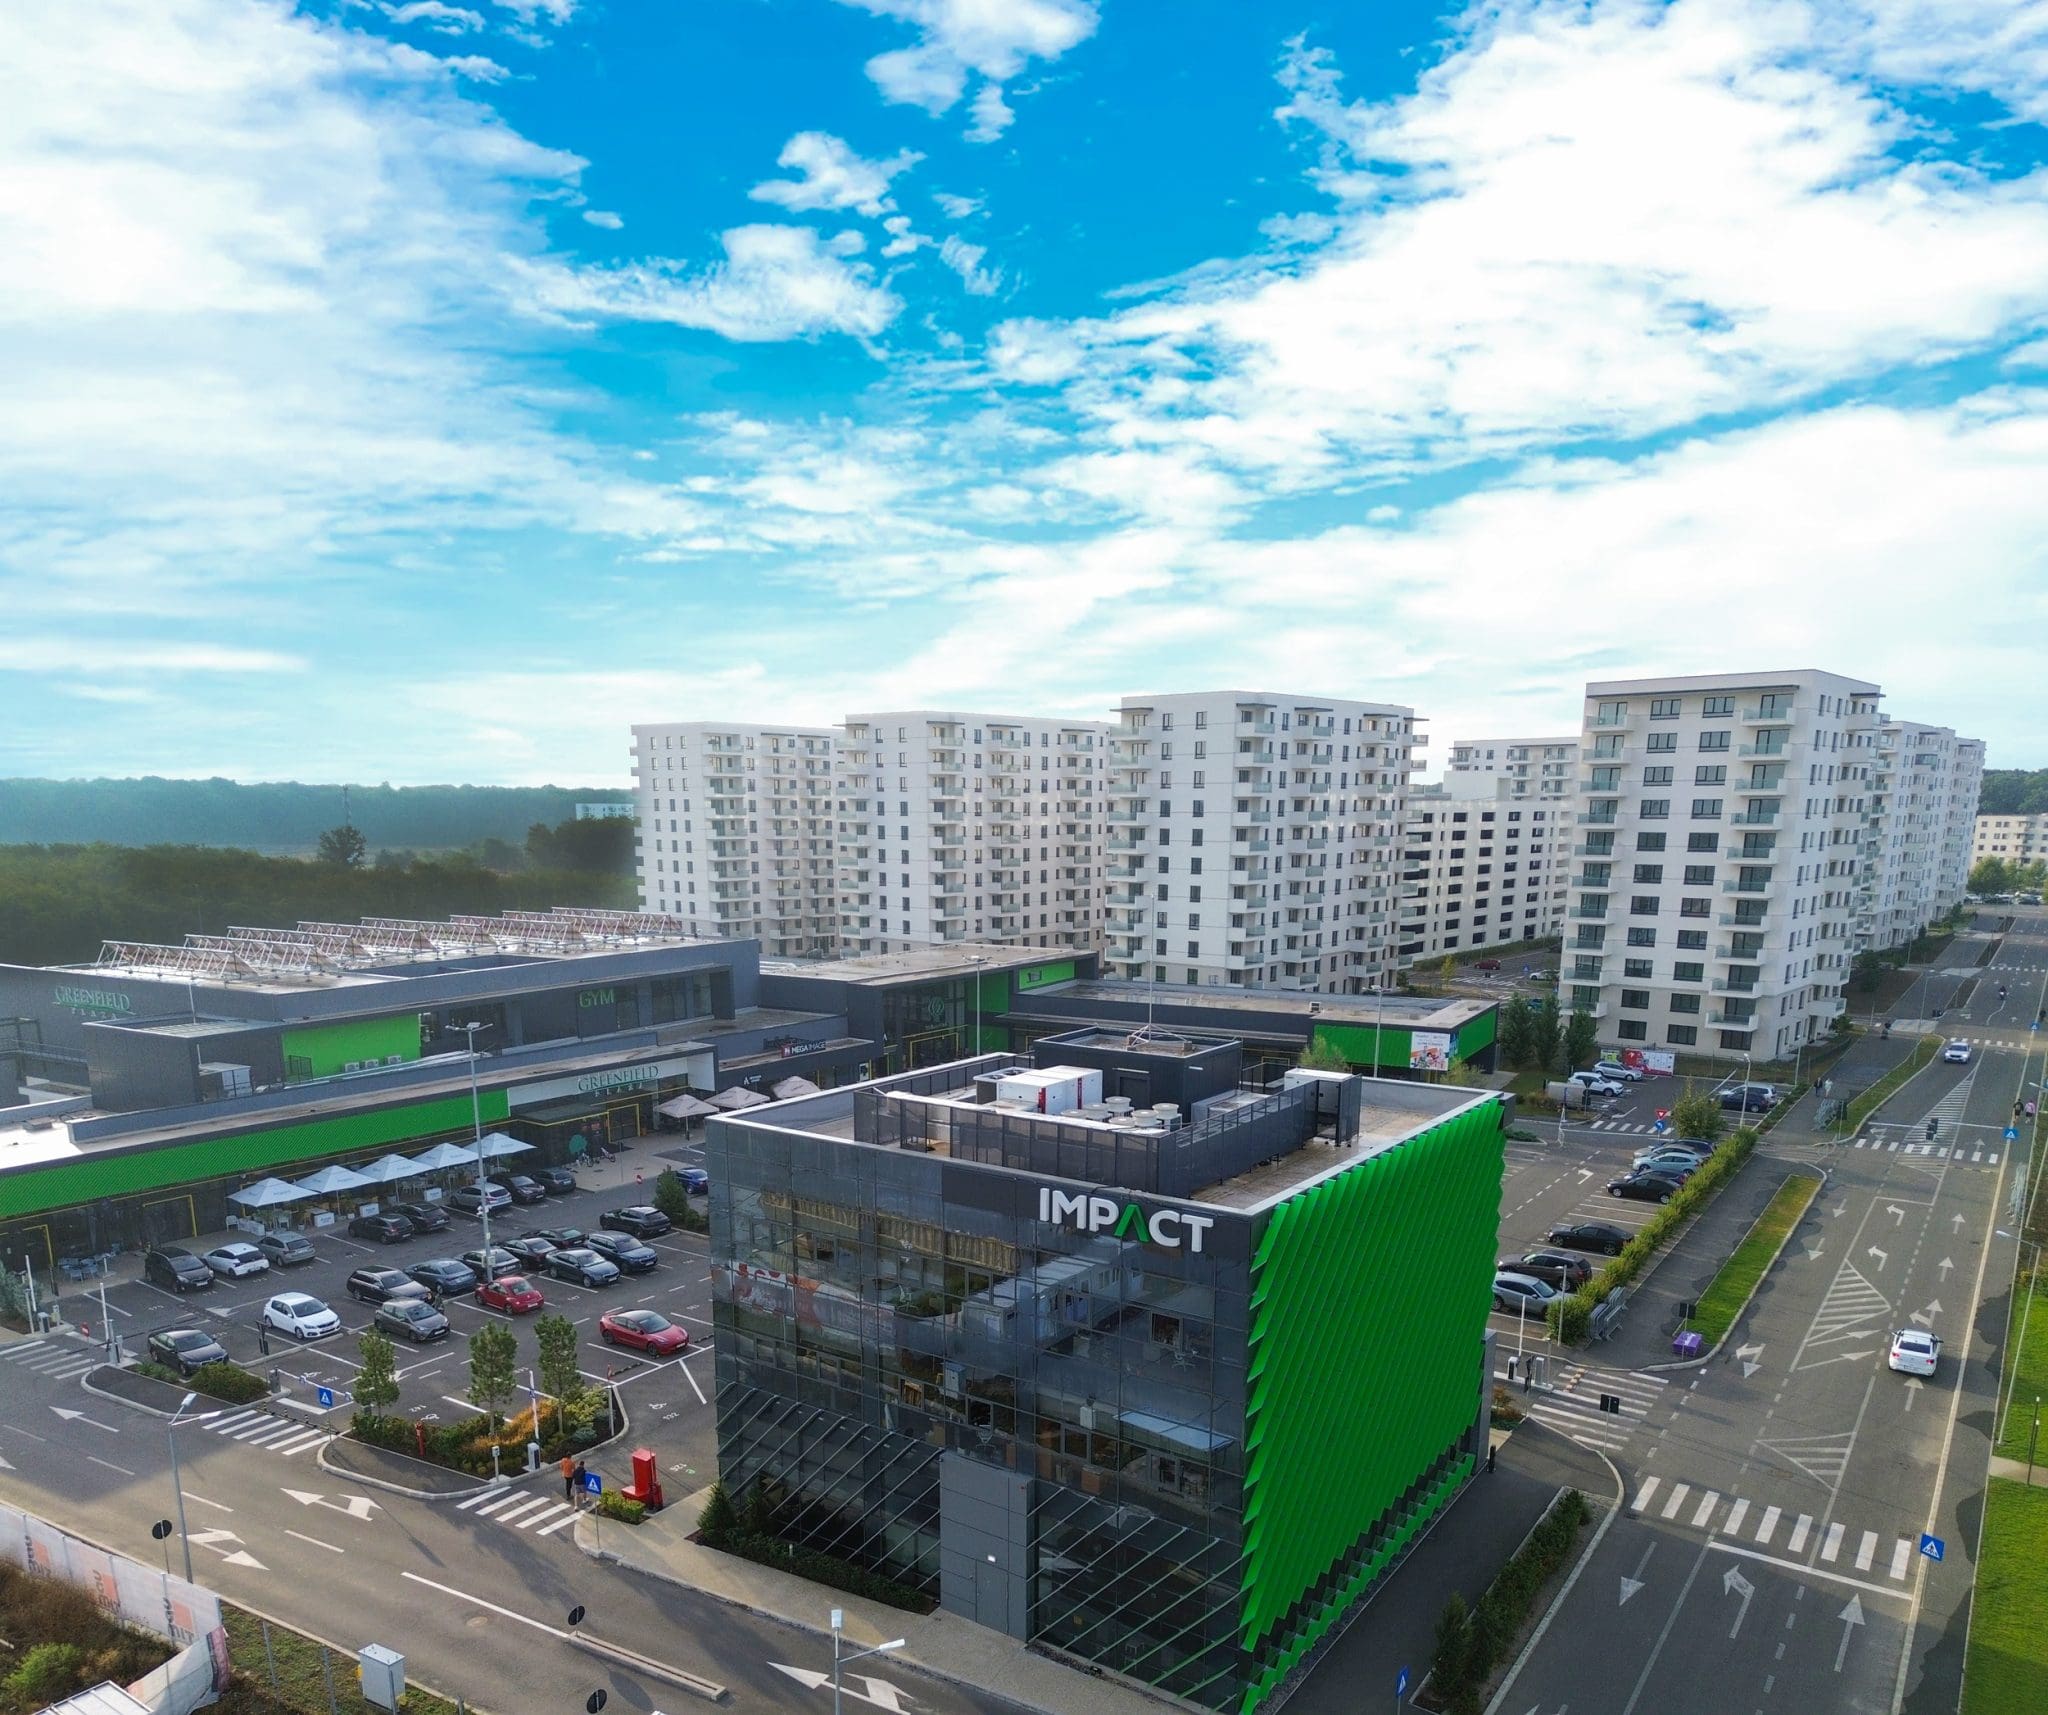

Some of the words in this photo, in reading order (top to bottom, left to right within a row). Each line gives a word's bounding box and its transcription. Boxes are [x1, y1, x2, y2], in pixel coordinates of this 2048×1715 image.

[54, 985, 131, 1012] GREENFIELD
[579, 989, 615, 1008] GYM
[791, 1044, 808, 1054] MEGA
[577, 1065, 660, 1092] GREENFIELD
[1039, 1187, 1214, 1253] IMPACT
